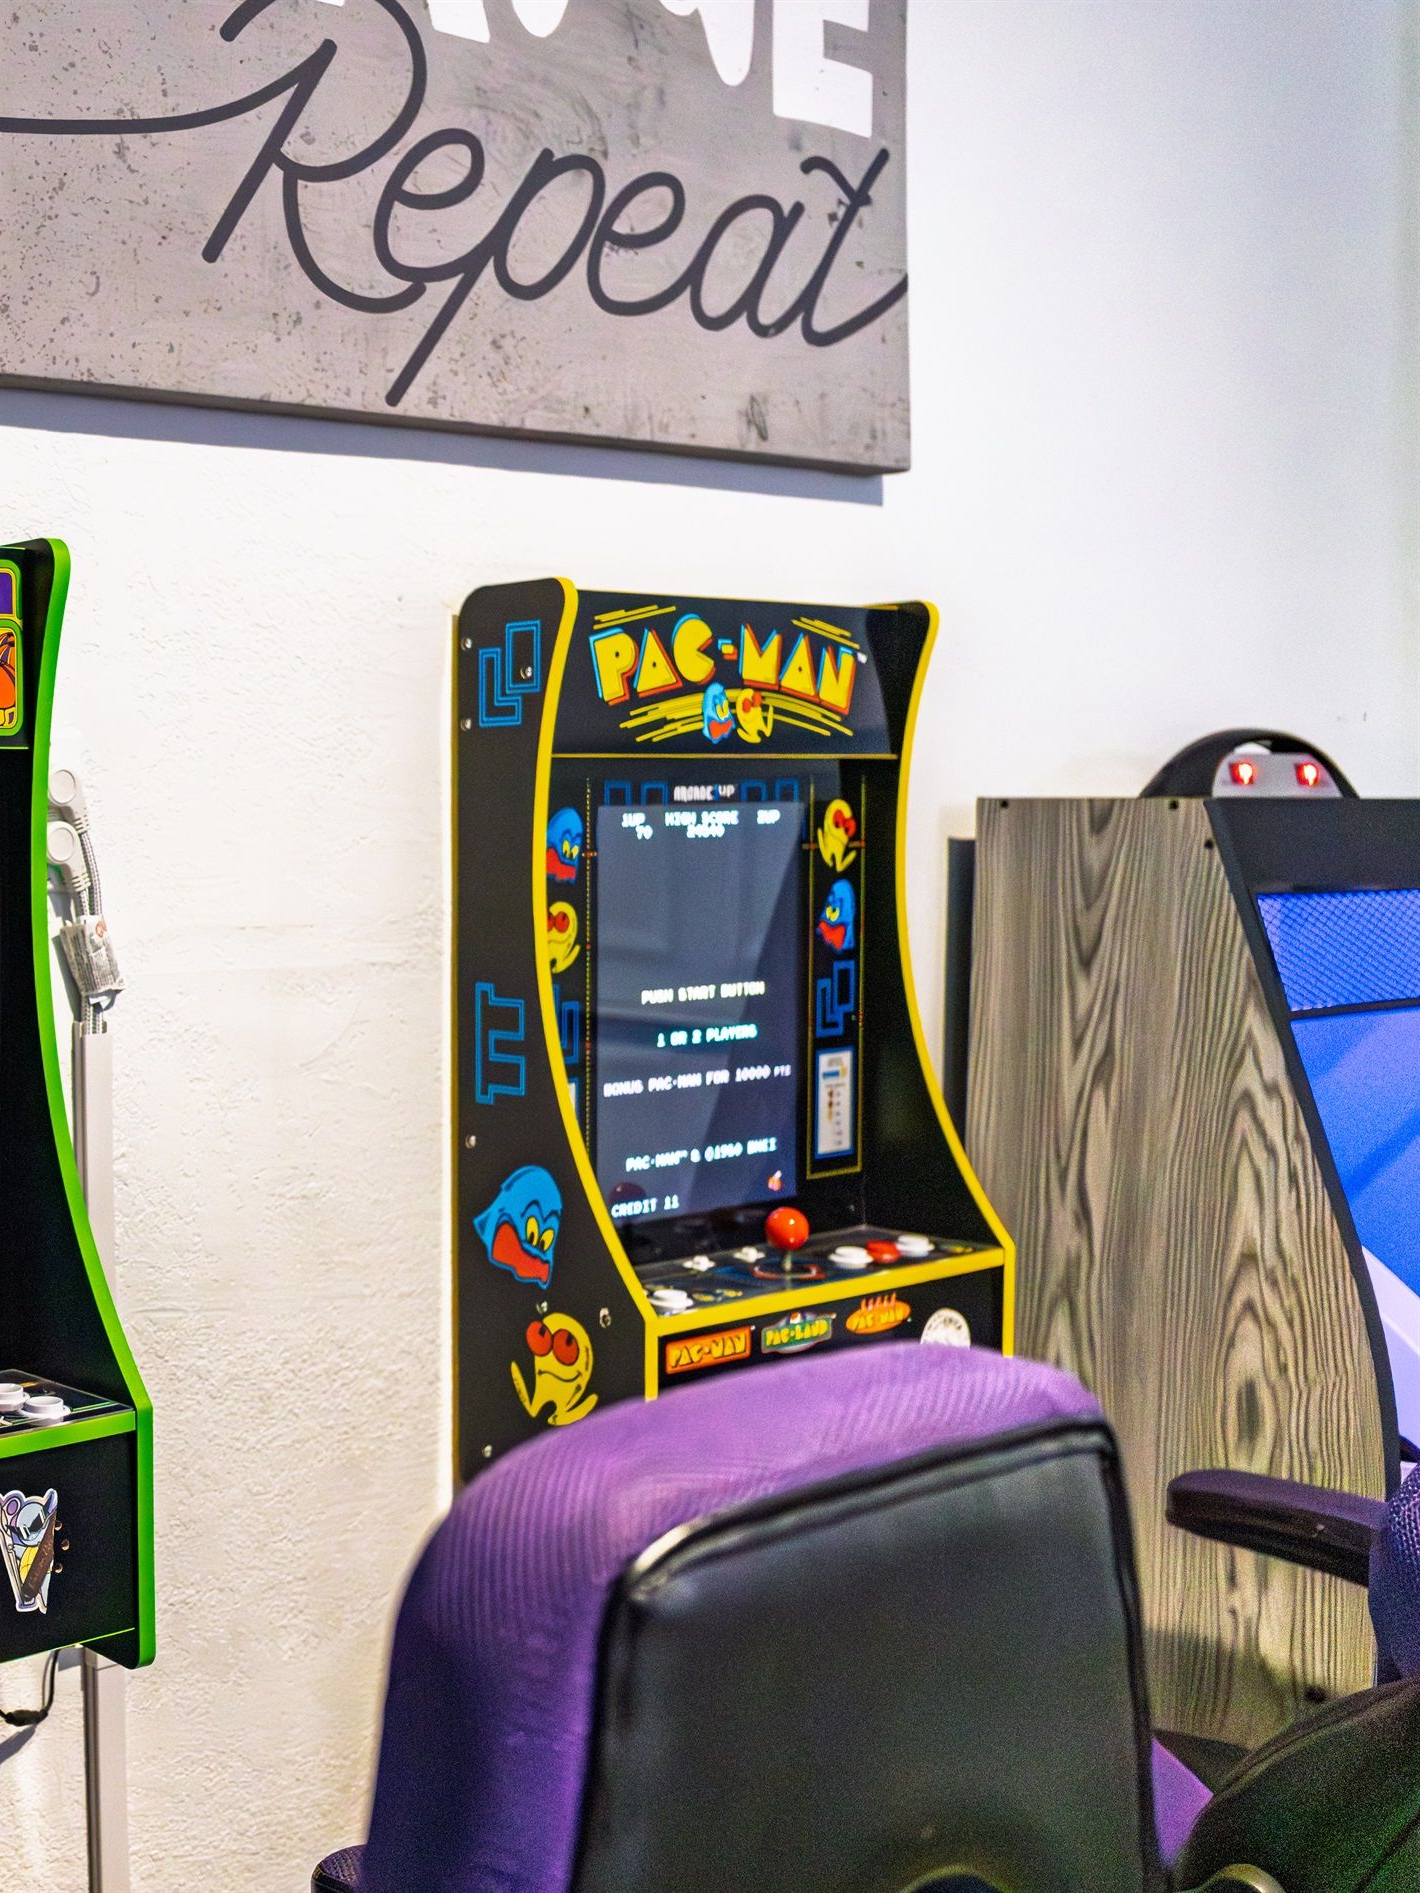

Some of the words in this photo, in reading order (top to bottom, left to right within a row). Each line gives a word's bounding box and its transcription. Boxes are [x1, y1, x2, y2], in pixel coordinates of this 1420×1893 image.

[205, 0, 910, 406] Repeat
[589, 613, 857, 715] PAC-MAN
[678, 984, 716, 1002] START
[720, 980, 765, 998] BUTTON
[705, 1023, 758, 1043] PLAYERS
[611, 1197, 658, 1218] CREDIT
